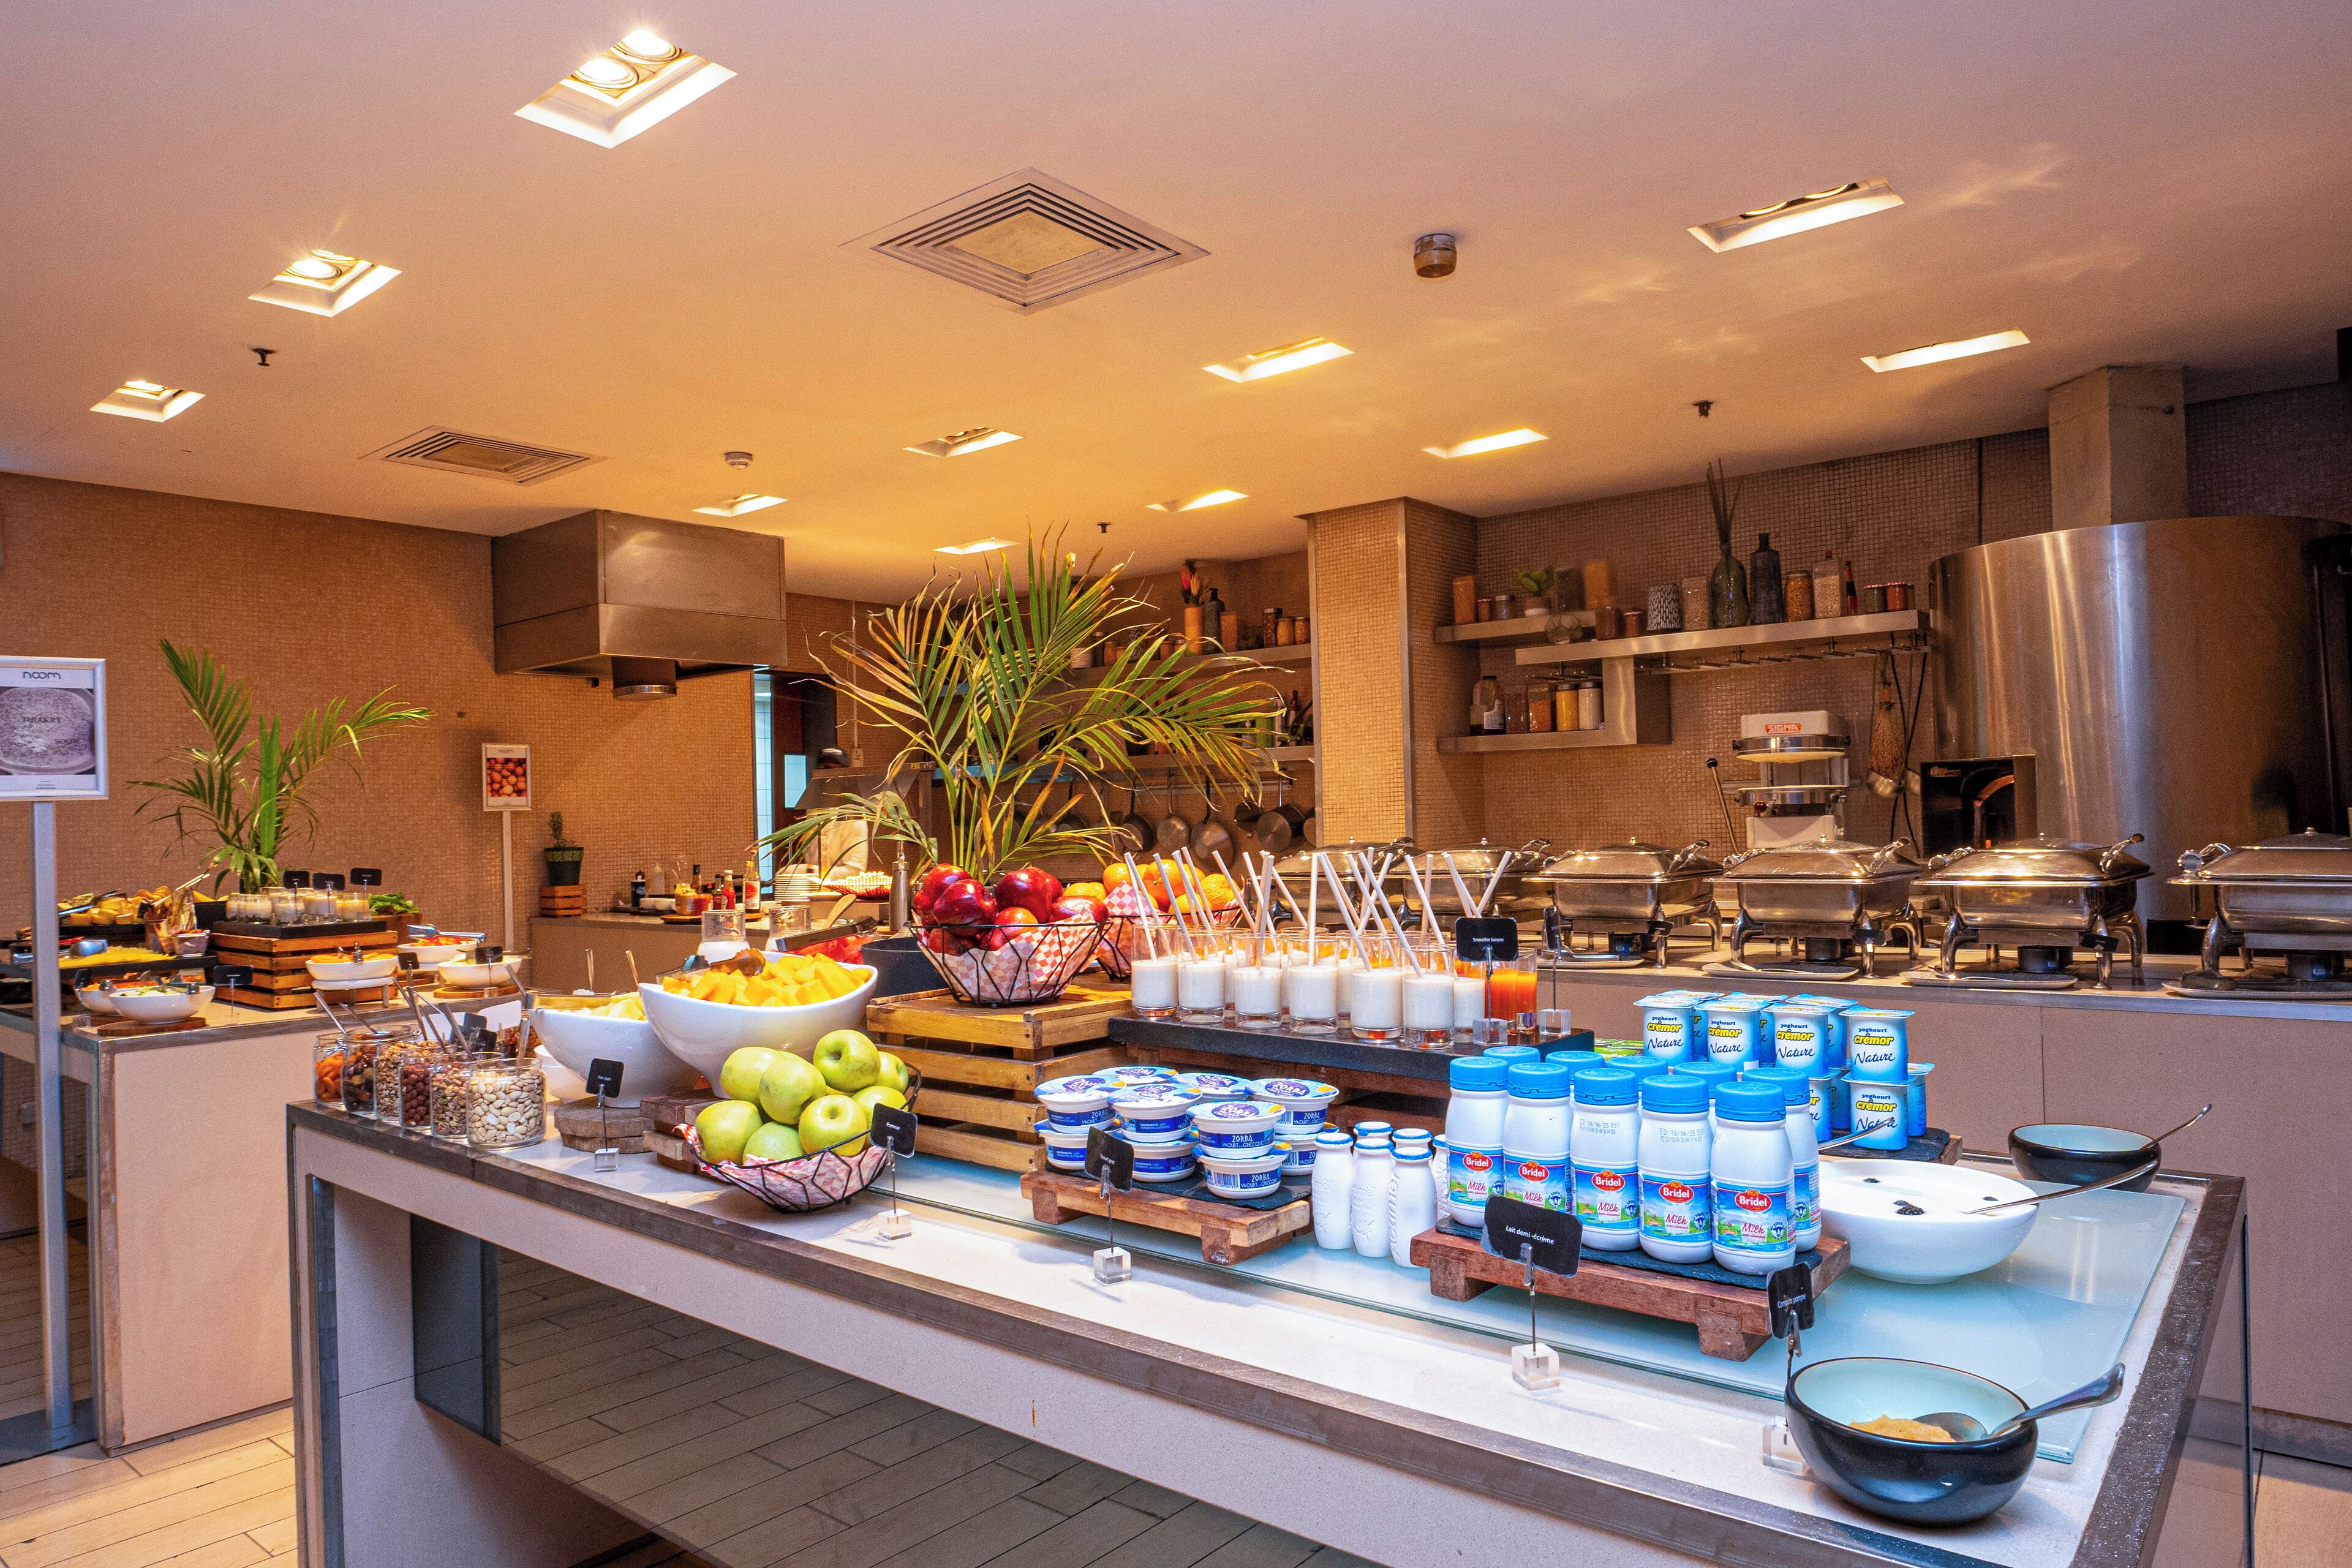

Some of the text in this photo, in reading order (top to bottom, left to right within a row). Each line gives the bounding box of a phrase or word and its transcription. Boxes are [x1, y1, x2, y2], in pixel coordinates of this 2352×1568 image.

[1647, 1037, 1684, 1050] Nature
[1709, 1042, 1744, 1054] Nature
[1776, 1046, 1815, 1059] Nature
[1854, 1051, 1896, 1066] Nature
[1091, 1109, 1108, 1119] ZORBA
[1466, 1156, 1489, 1167] Bridel
[1522, 1166, 1545, 1177] Bridel
[1251, 1172, 1270, 1183] ZORBA
[1596, 1176, 1621, 1186] Bridel
[1468, 1180, 1487, 1191] Milk
[1524, 1191, 1544, 1202] Milk
[1663, 1187, 1690, 1198] Bridel
[1739, 1195, 1768, 1207] Bridel
[1598, 1202, 1619, 1212] Milk
[1665, 1213, 1688, 1224] Milk
[1516, 1229, 1531, 1237] demi
[1741, 1222, 1765, 1234] Milk
[1777, 1298, 1793, 1308] Compote
